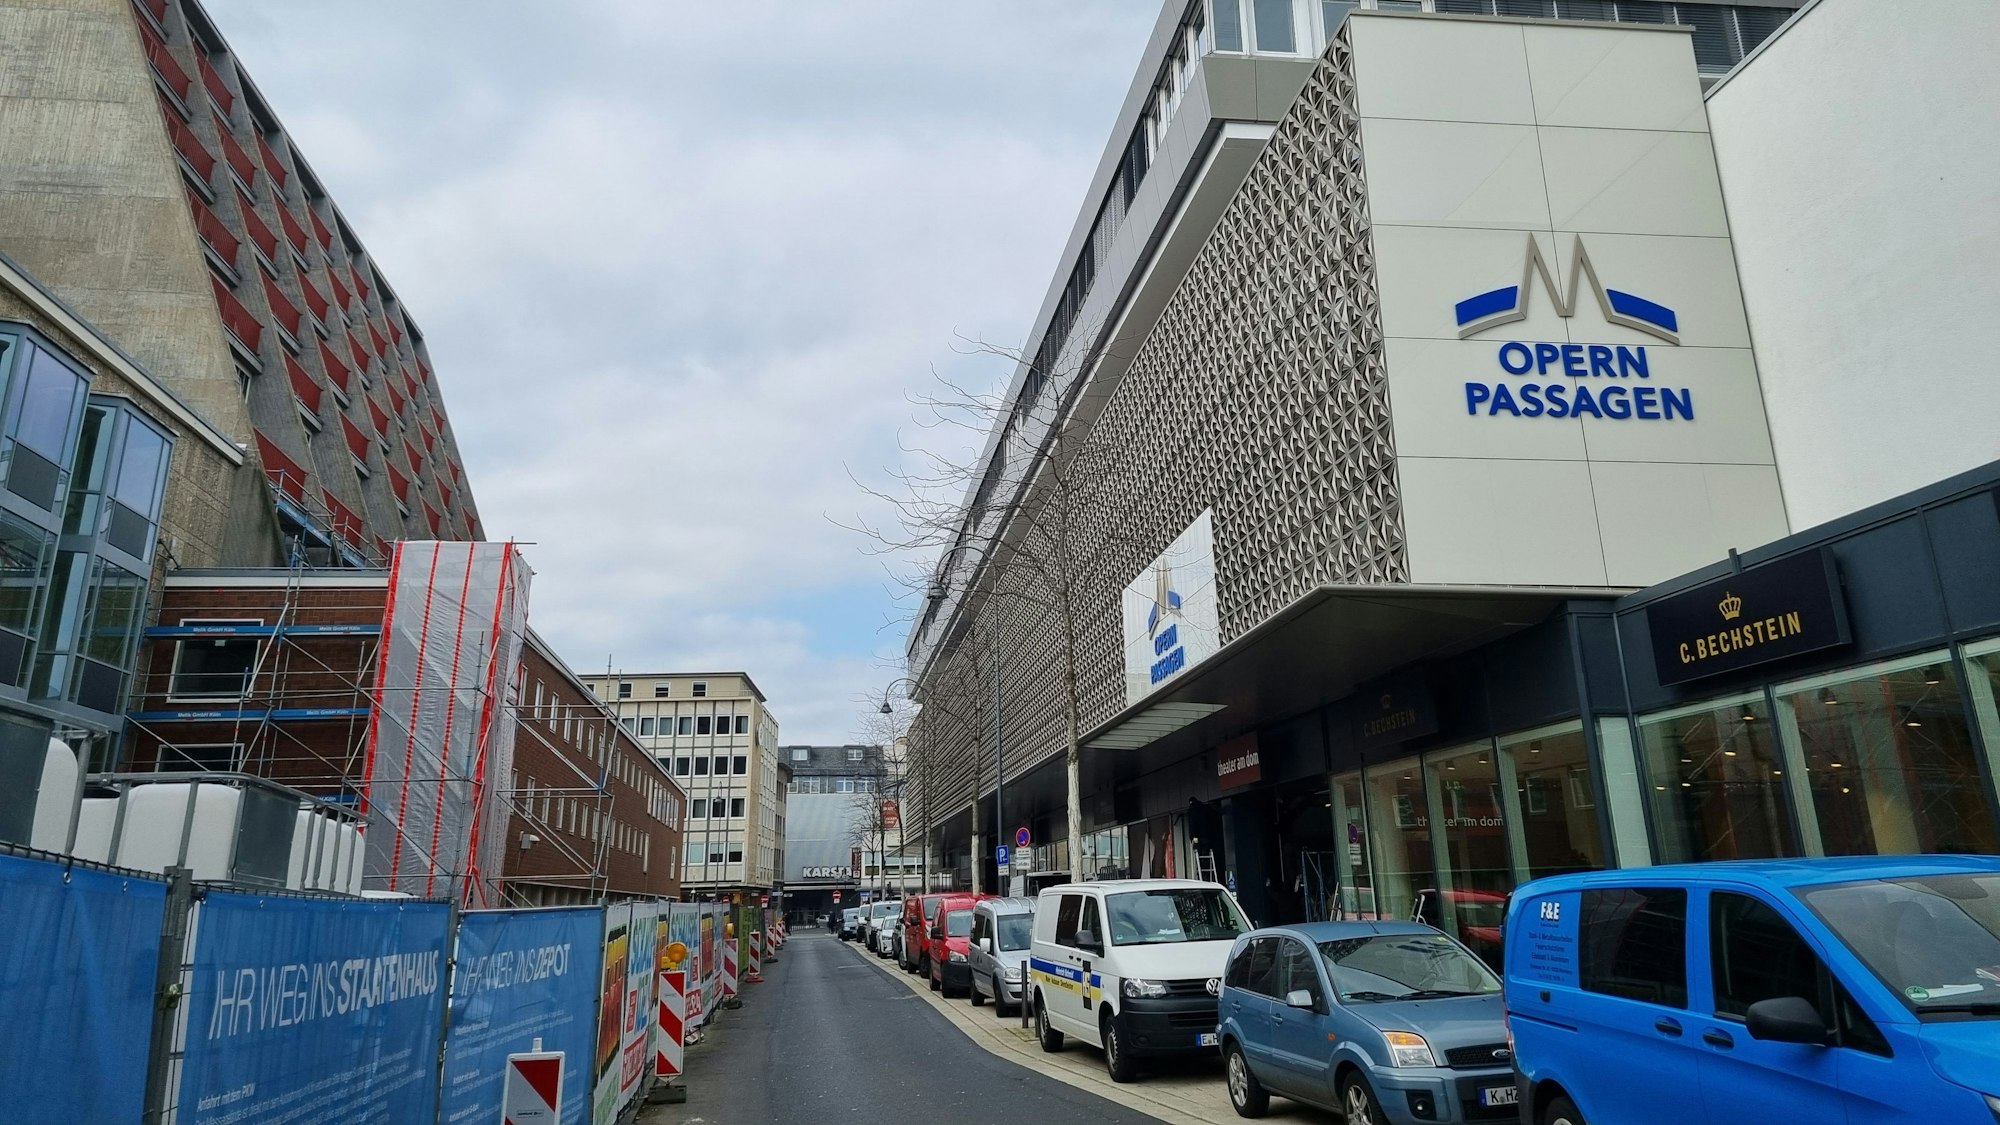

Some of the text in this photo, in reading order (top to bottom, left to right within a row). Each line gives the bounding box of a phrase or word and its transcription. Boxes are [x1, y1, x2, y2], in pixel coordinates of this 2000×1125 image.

[1498, 341, 1650, 379] OPERN
[1465, 382, 1694, 421] PASSAGEN
[1154, 623, 1178, 656] OPERN
[1150, 645, 1185, 685] PASSAGEN
[1217, 749, 1260, 777] theater am dom
[1480, 816, 1504, 827] dom
[1540, 901, 1560, 920] F&E
[514, 948, 536, 985] INS
[533, 943, 571, 981] DEPOT
[208, 969, 256, 1040] IHR
[260, 964, 309, 1031] WEG
[309, 960, 339, 1021] INS
